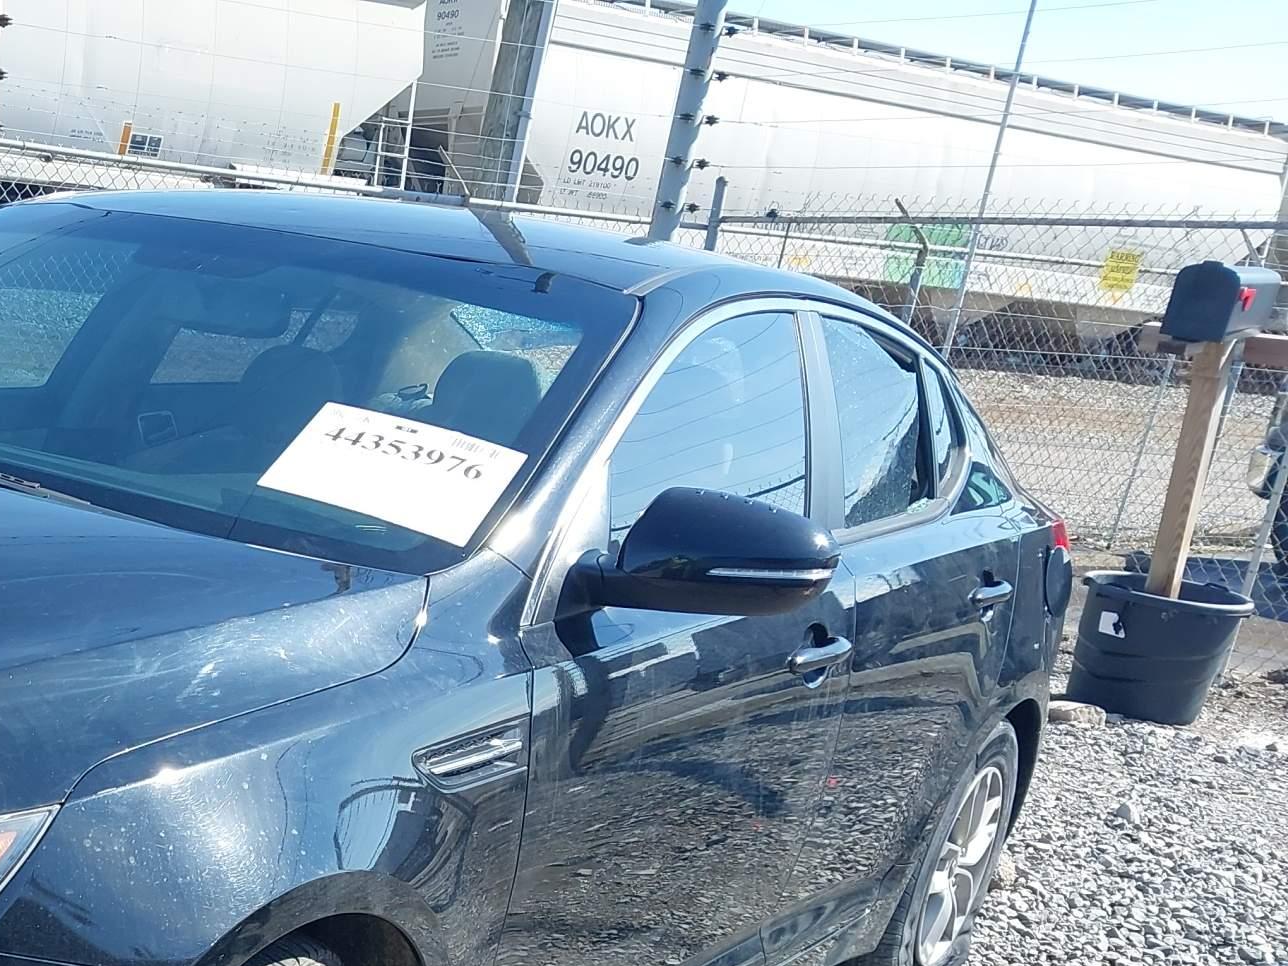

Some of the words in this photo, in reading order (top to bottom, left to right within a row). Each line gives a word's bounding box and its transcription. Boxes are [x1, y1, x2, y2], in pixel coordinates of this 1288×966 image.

[575, 111, 636, 142] AOKX
[568, 149, 639, 181] 90490
[324, 427, 483, 480] 44353976
